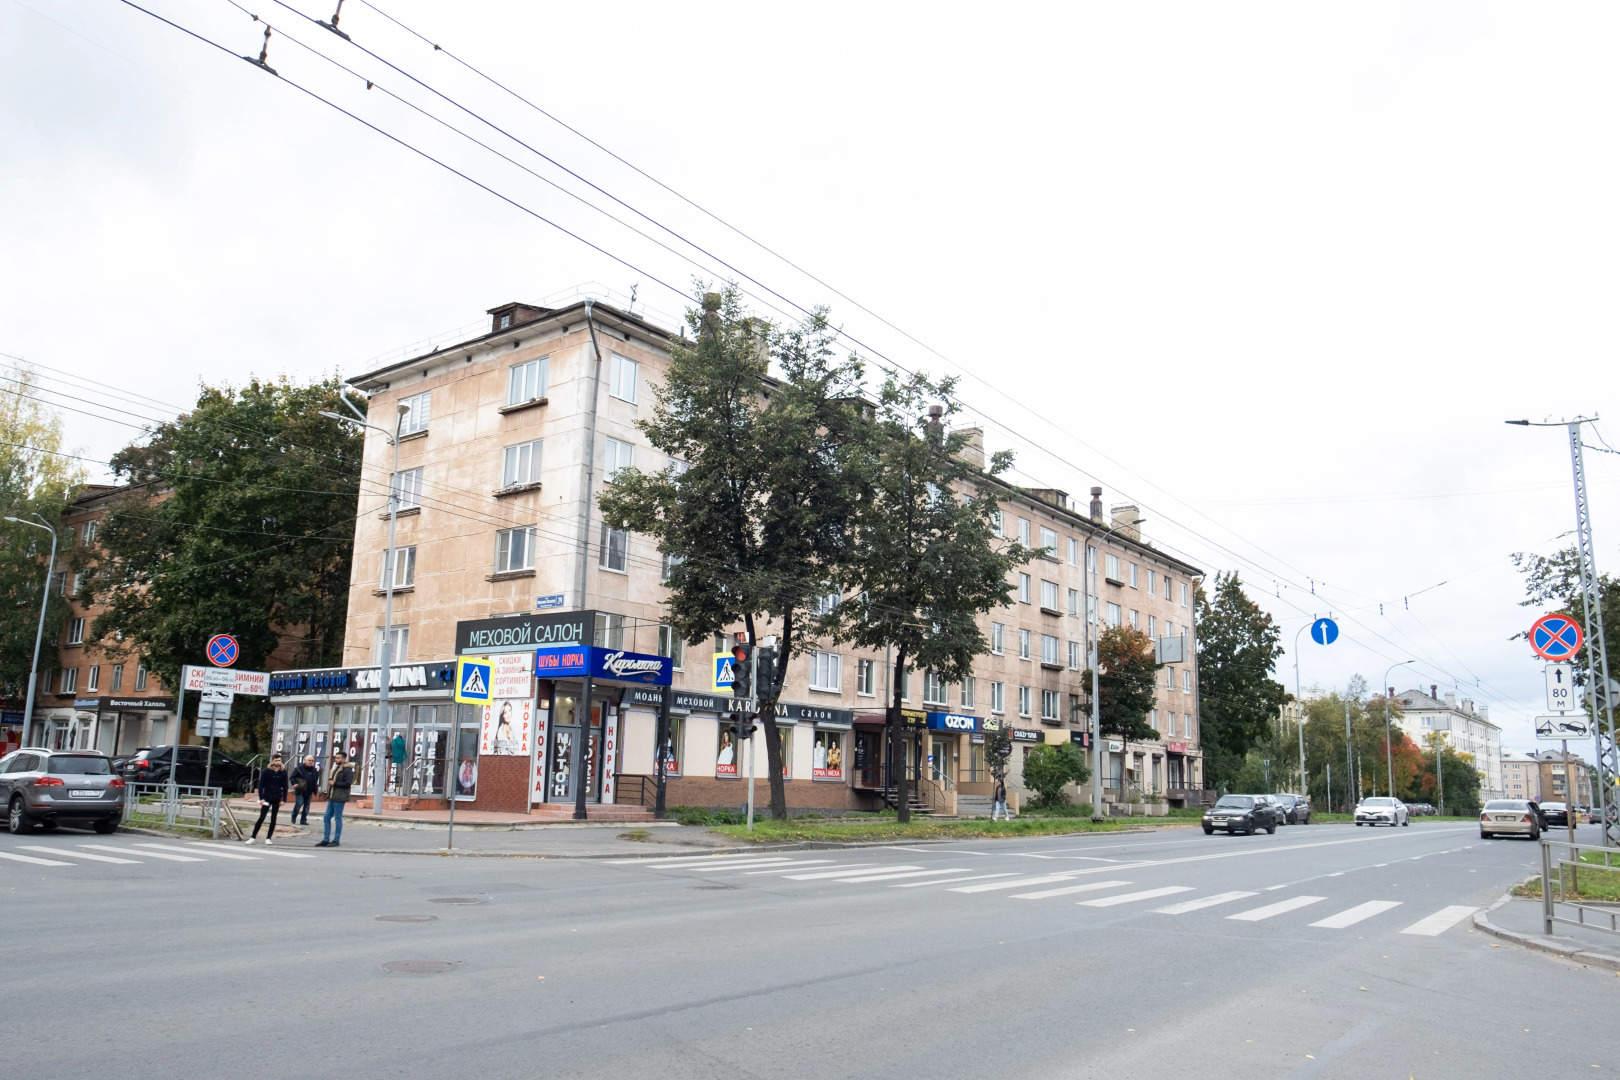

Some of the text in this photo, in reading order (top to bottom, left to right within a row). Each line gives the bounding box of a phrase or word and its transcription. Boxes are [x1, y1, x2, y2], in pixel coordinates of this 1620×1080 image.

[469, 622, 583, 647] МЕХОВОЙ САЛОН
[498, 655, 522, 664] СКИДКИ
[538, 653, 584, 667] ШУБЫ НОРКА
[191, 669, 205, 678] СКИ
[493, 676, 529, 685] СОРТИМЕНТ
[1552, 688, 1568, 698] 80
[110, 699, 142, 707] Восточный
[521, 701, 530, 752] НОРКА
[944, 715, 974, 730] OZON
[424, 732, 439, 793] МЕХА
[535, 720, 545, 792] НОРКА
[604, 726, 614, 794] НОРКА
[554, 732, 570, 796] МУТОН
[717, 764, 735, 773] НОРКА
[813, 769, 826, 777] ОРКА
